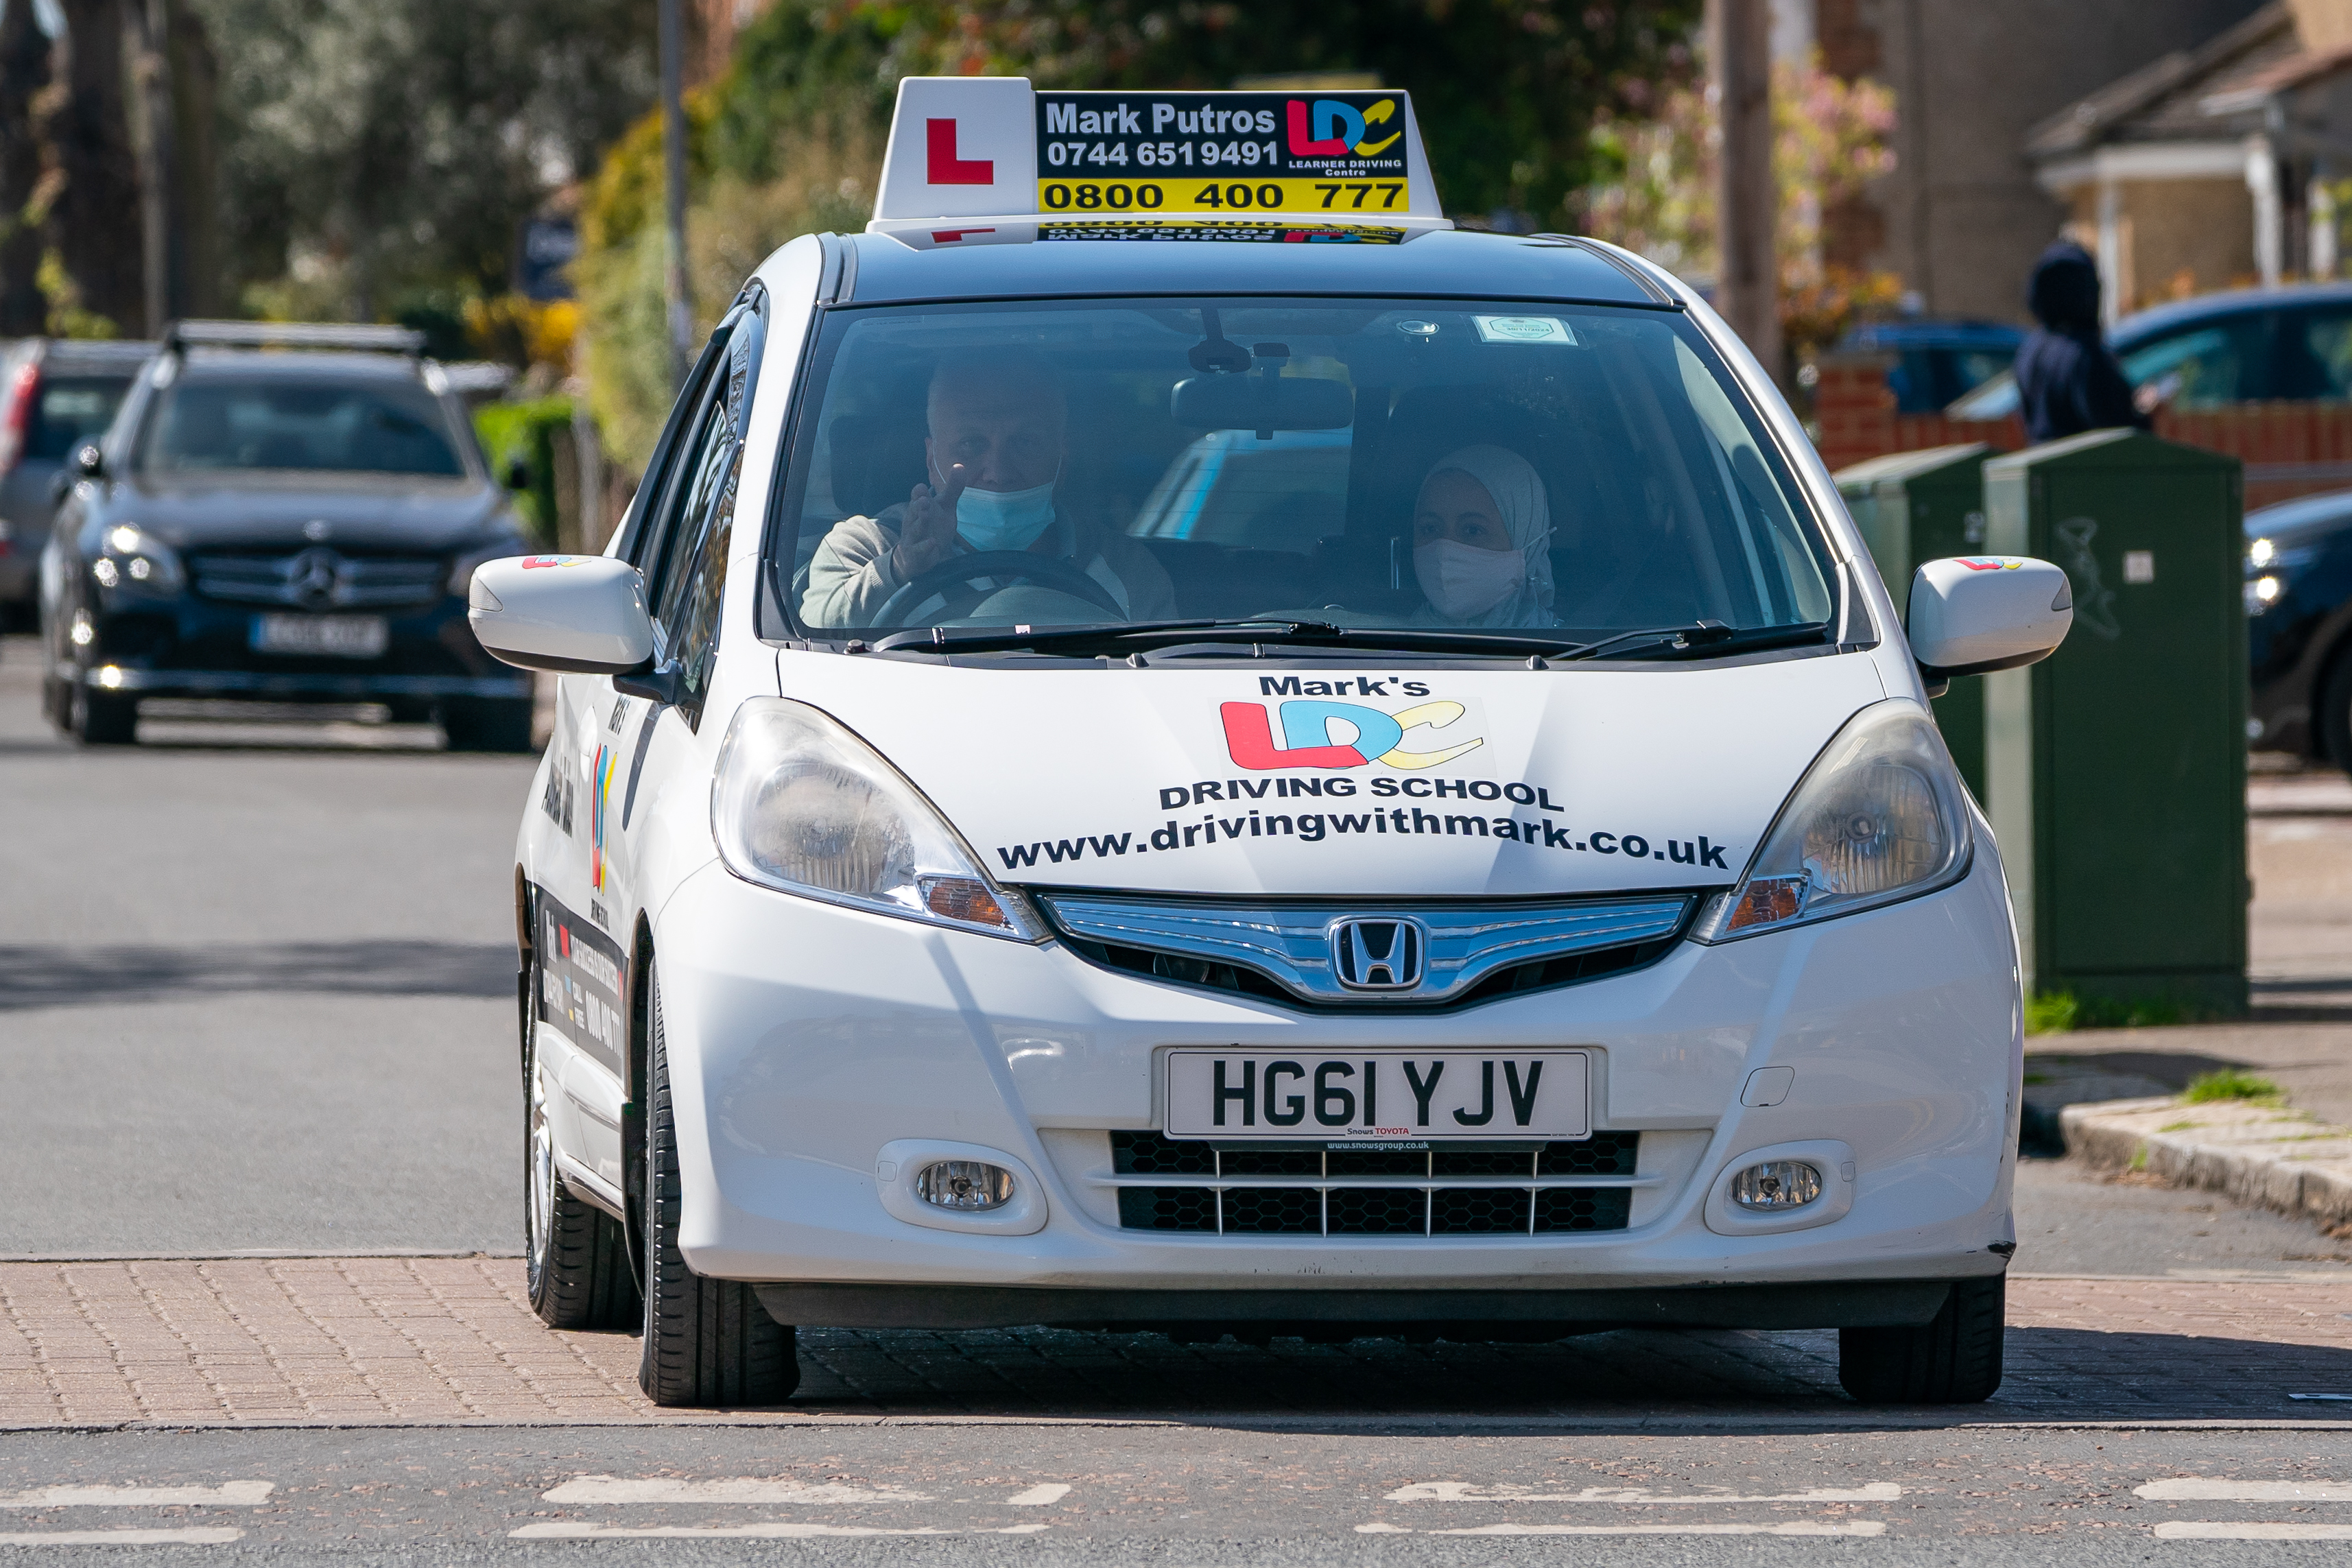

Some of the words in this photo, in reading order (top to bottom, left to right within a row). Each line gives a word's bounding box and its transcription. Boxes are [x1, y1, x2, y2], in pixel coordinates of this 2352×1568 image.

[1046, 103, 1141, 134] Mark
[1152, 103, 1276, 134] Putros
[1286, 99, 1401, 157] LDC
[926, 118, 994, 185] L
[1047, 141, 1129, 166] 0744
[1137, 141, 1193, 166] 651
[1201, 141, 1278, 166] 9491
[1288, 160, 1346, 169] LEARNER
[1349, 159, 1402, 168] DRIVING
[1043, 183, 1164, 209] 0800
[1193, 182, 1284, 209] 400
[1314, 182, 1404, 209] 777
[1259, 675, 1431, 698] Mark's
[1220, 699, 1484, 771] LDC
[1159, 776, 1357, 811] DRIVING
[1371, 776, 1566, 813] SCHOOL
[997, 808, 1729, 871] www.drivingwithmark.co.uk
[1212, 1060, 1377, 1127] HG61
[1402, 1060, 1544, 1127] YJV
[1327, 1141, 1429, 1151] www.snowsgroup.co.uk
